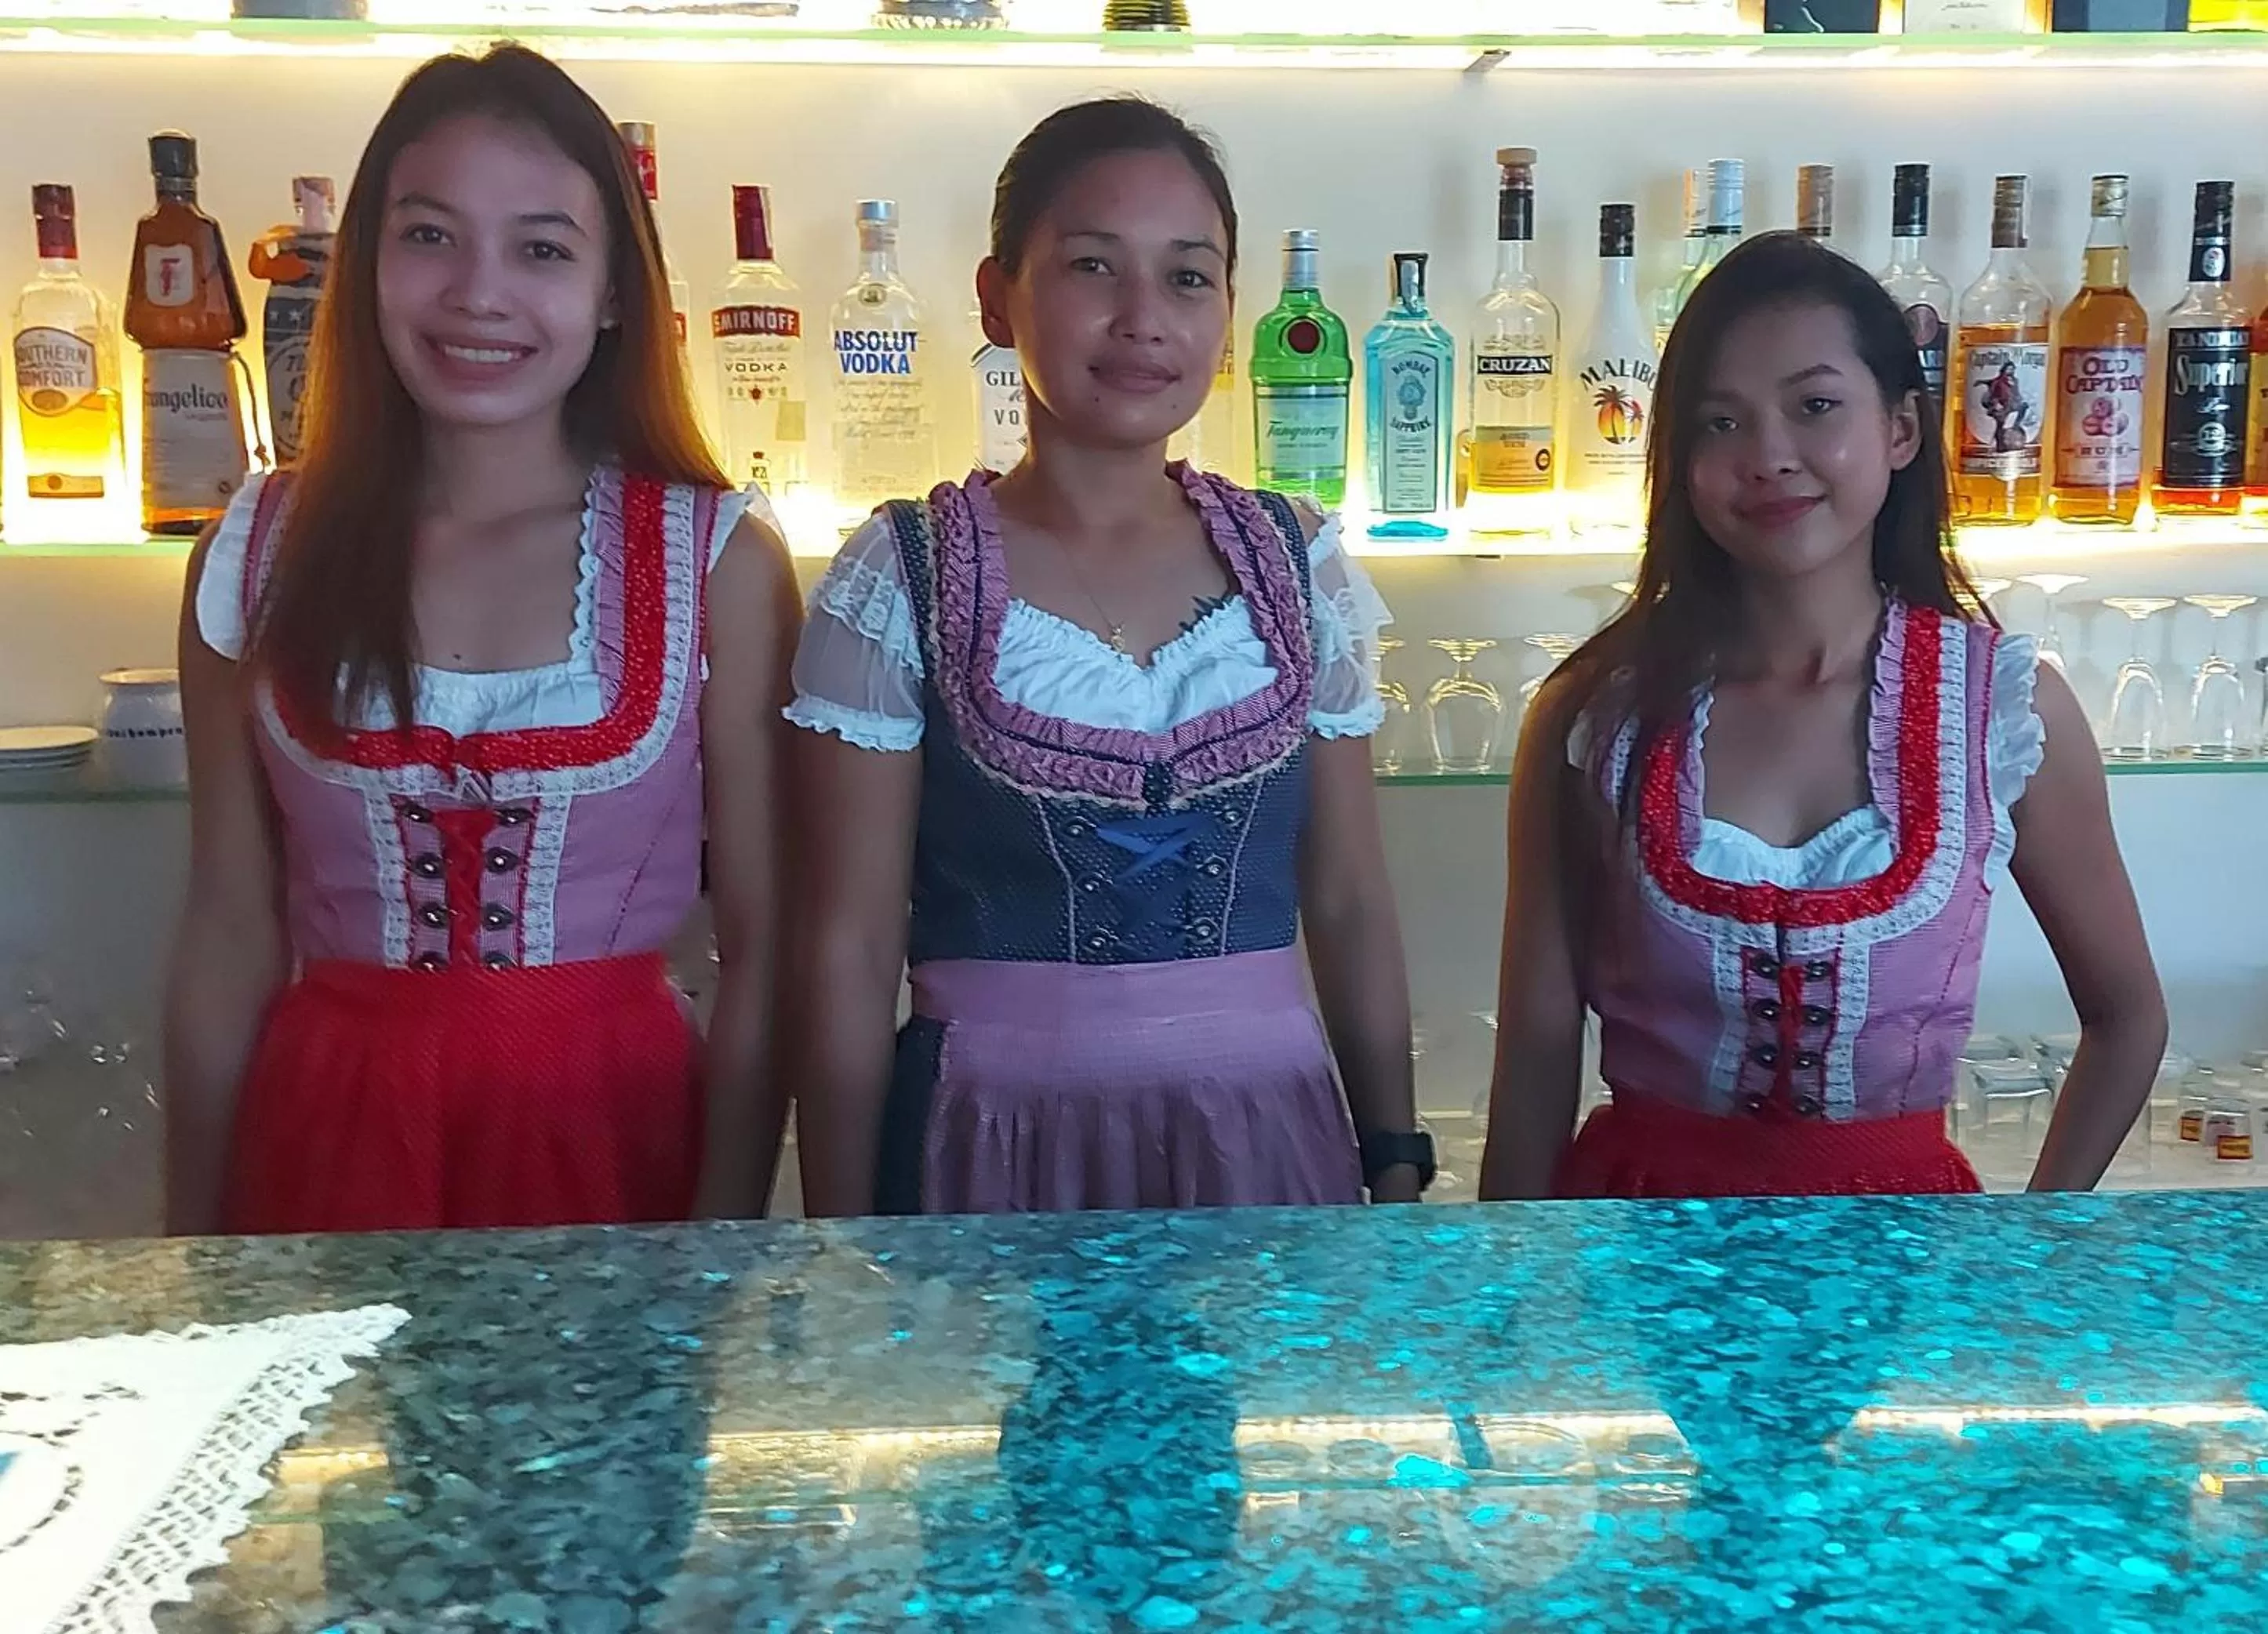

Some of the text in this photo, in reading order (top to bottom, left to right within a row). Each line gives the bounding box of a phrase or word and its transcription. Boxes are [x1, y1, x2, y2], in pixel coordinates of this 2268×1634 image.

[714, 310, 796, 332] SMIRNOFF
[834, 330, 918, 352] ABSOLUT
[725, 362, 787, 372] VODKA
[840, 353, 911, 374] VODKA
[1478, 358, 1551, 372] CRUZAN
[2082, 357, 2129, 376] OLD
